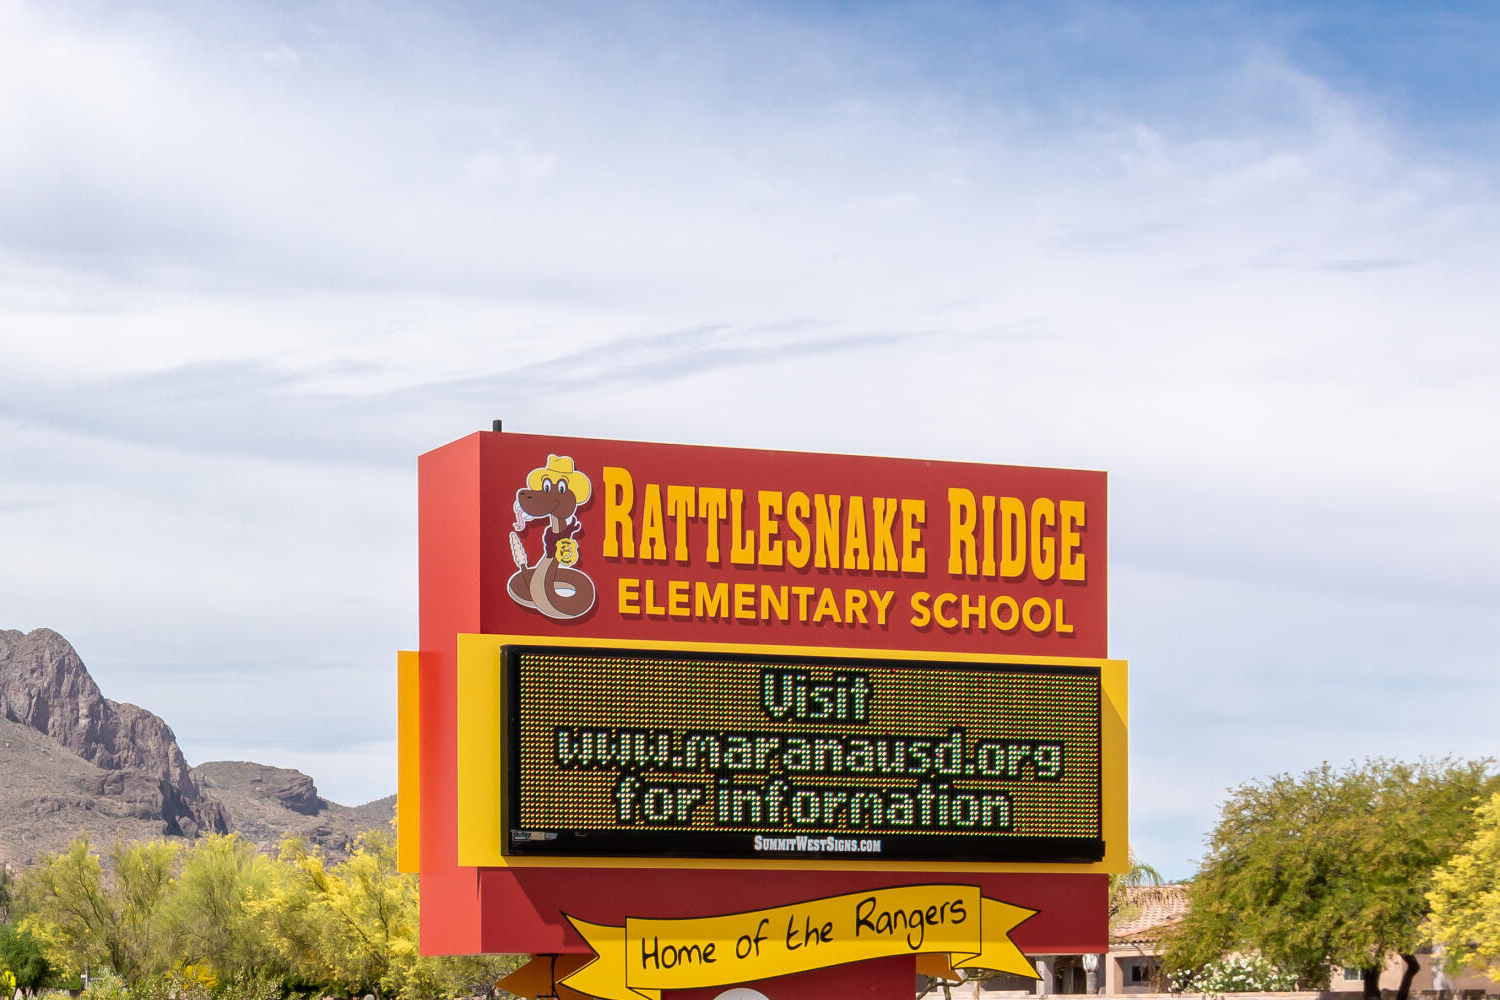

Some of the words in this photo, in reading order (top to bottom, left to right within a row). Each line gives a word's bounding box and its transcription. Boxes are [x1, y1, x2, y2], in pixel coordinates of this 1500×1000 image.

[602, 466, 926, 574] RATTLESNAKE
[947, 487, 1086, 581] RIDGE
[617, 577, 895, 626] ELEMENTARY
[910, 590, 1074, 634] SCHOOL
[764, 673, 869, 720] Visit
[558, 731, 1062, 778] www.maranausd.org
[616, 776, 702, 821] for
[718, 778, 1010, 827] information
[641, 935, 717, 971] Home
[735, 917, 770, 960] of
[785, 913, 835, 952] the
[854, 896, 968, 950] Rangers
